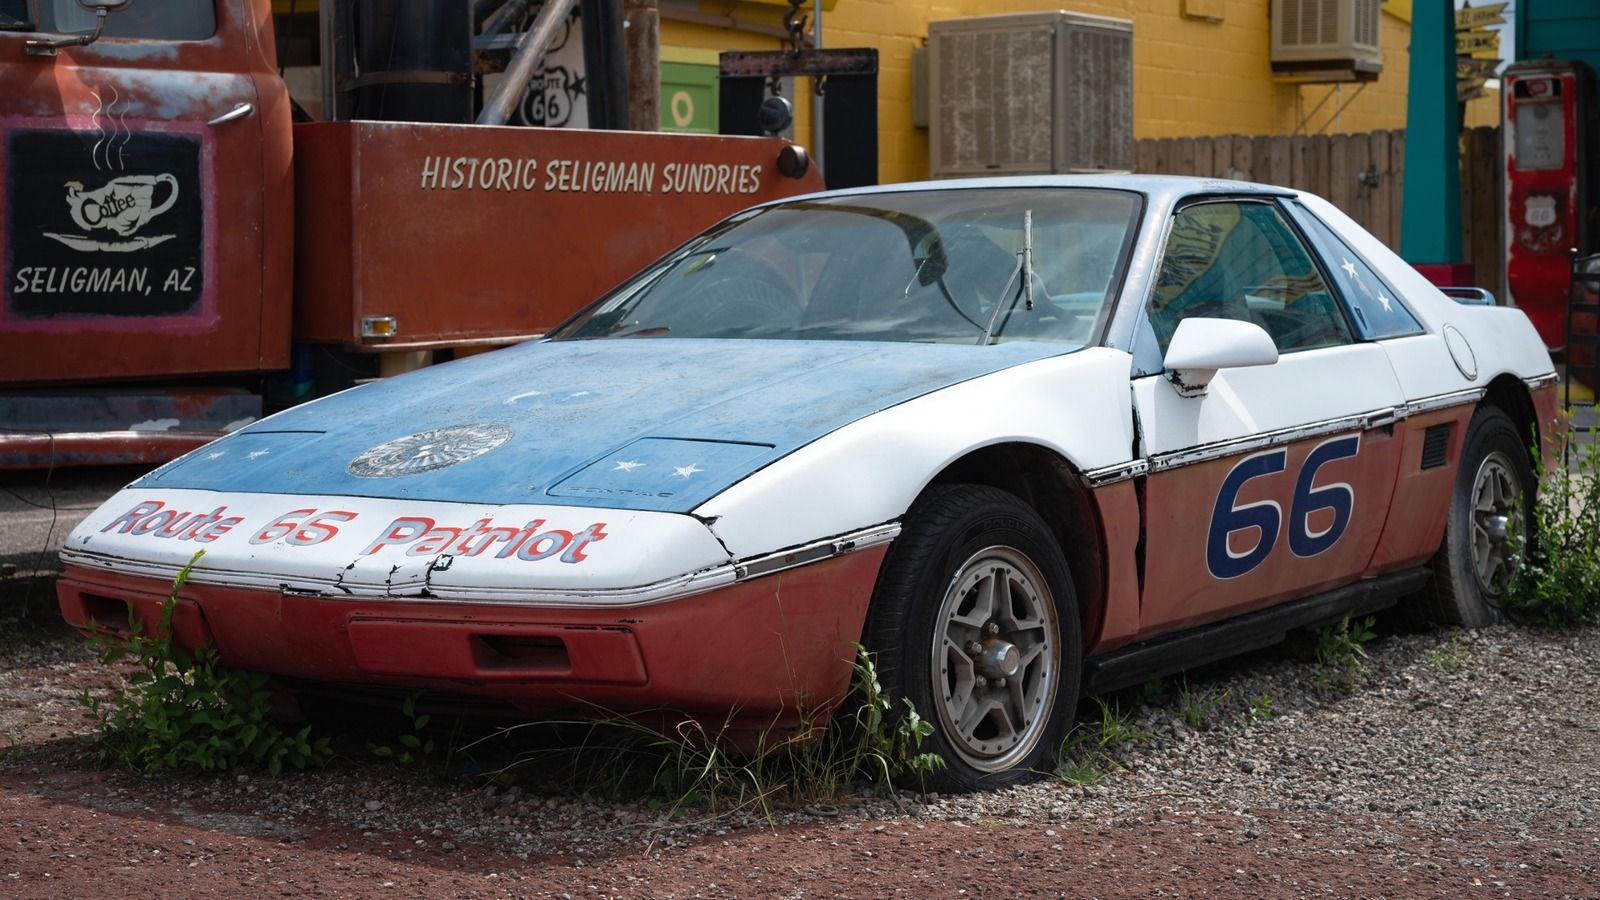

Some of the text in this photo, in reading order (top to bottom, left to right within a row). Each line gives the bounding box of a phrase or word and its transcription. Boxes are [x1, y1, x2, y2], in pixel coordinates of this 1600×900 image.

[530, 78, 561, 89] ROUTE
[531, 95, 560, 122] 66
[420, 156, 762, 195] HISTORIC SELIGMAN SUNDRIES
[80, 192, 137, 226] Coffee
[14, 266, 196, 296] SELIGMAN, AZ
[1205, 433, 1362, 580] 66
[99, 500, 608, 565] Route 66 Patriot
